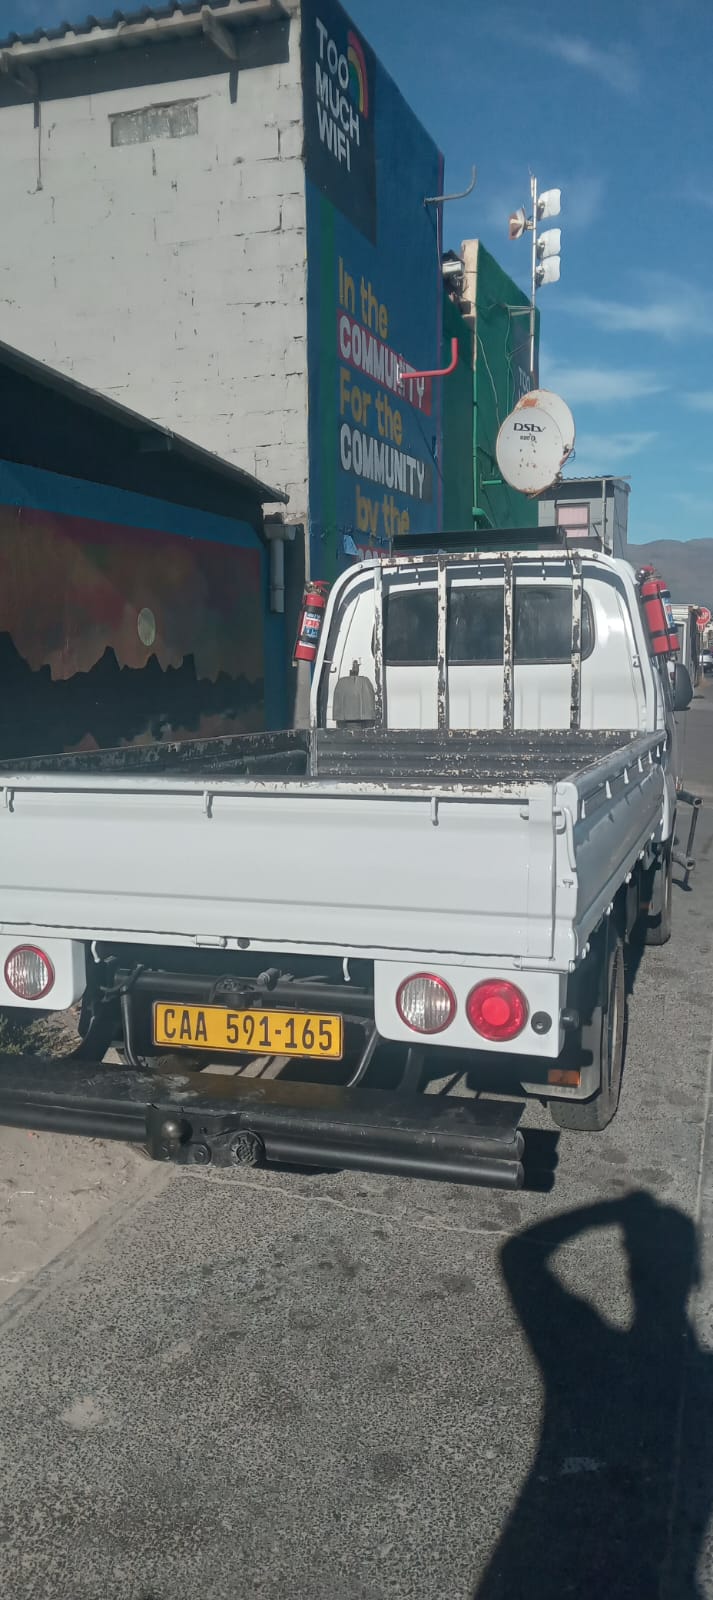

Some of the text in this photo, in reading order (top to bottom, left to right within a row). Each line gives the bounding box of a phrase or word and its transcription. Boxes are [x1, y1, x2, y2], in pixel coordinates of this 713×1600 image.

[315, 17, 349, 89] TOO
[315, 62, 360, 146] MUCH
[316, 101, 351, 172] WIFI
[338, 256, 389, 340] In the
[339, 314, 426, 408] COMMUNITY
[339, 367, 403, 446] For the
[339, 423, 426, 500] COMMUNITY
[356, 484, 410, 546] by the
[163, 1008, 333, 1051] CAA 591-165
